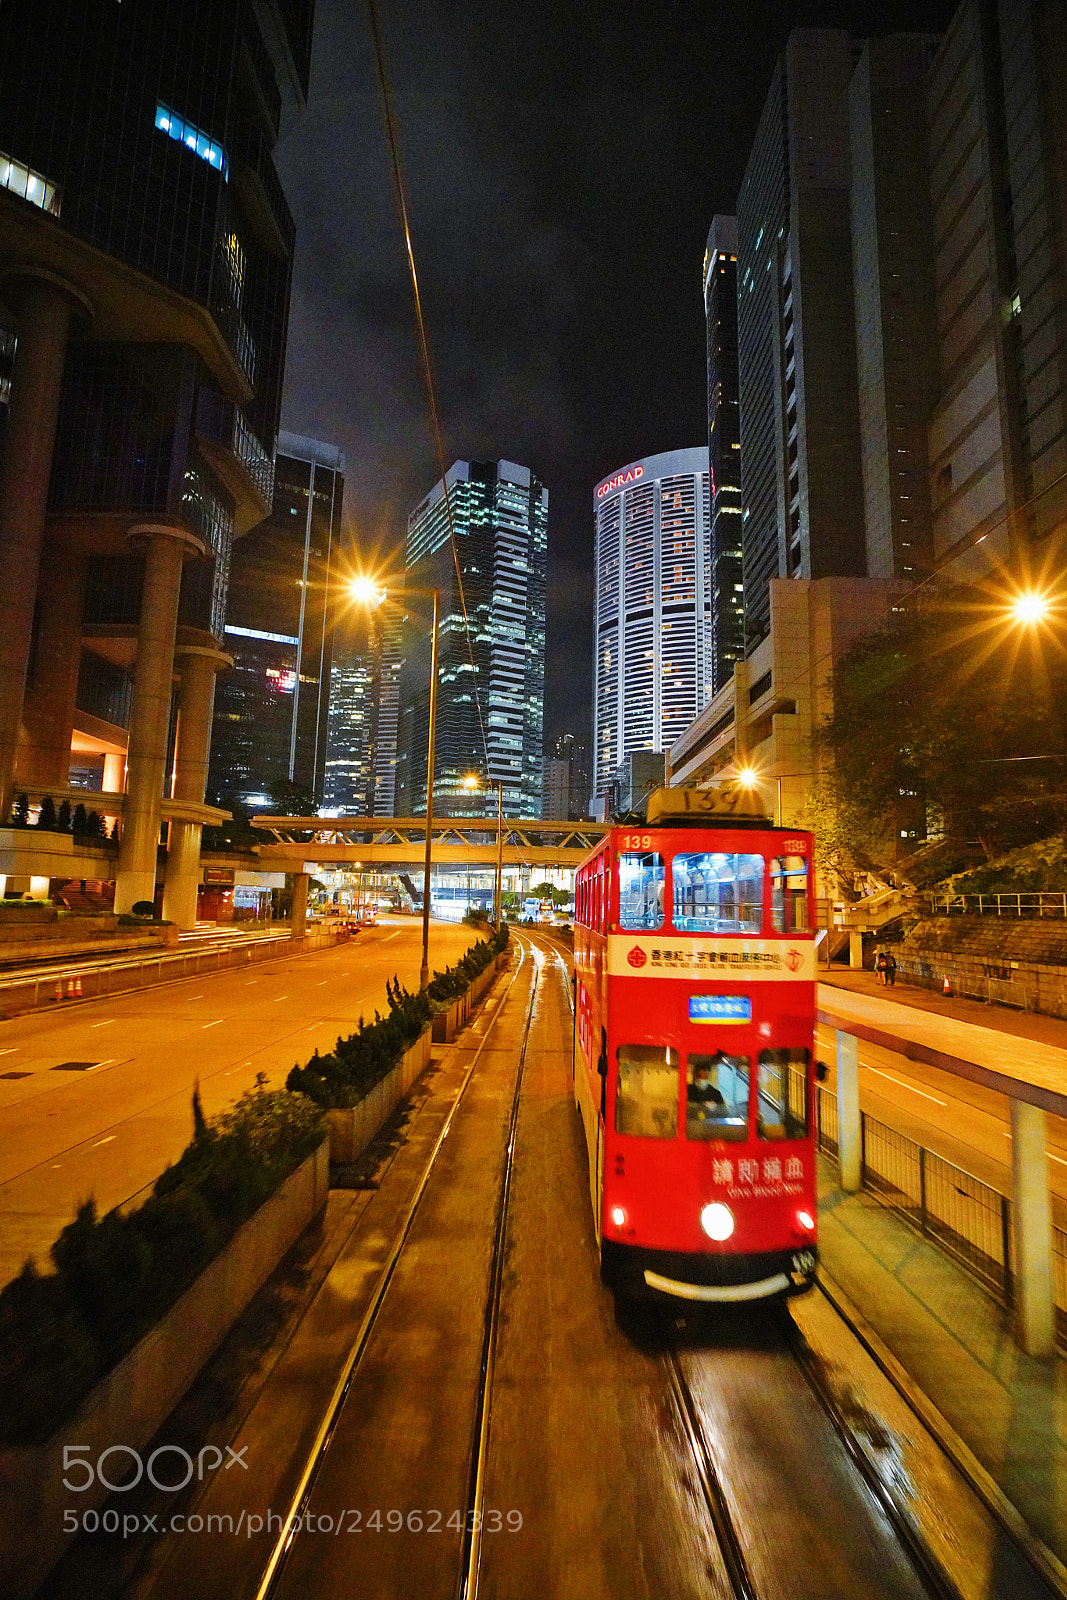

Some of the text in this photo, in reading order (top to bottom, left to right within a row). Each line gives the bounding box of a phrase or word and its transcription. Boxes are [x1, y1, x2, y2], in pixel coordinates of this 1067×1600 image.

[596, 466, 645, 499] CONRAD
[682, 790, 740, 813] 139
[623, 835, 652, 850] 139
